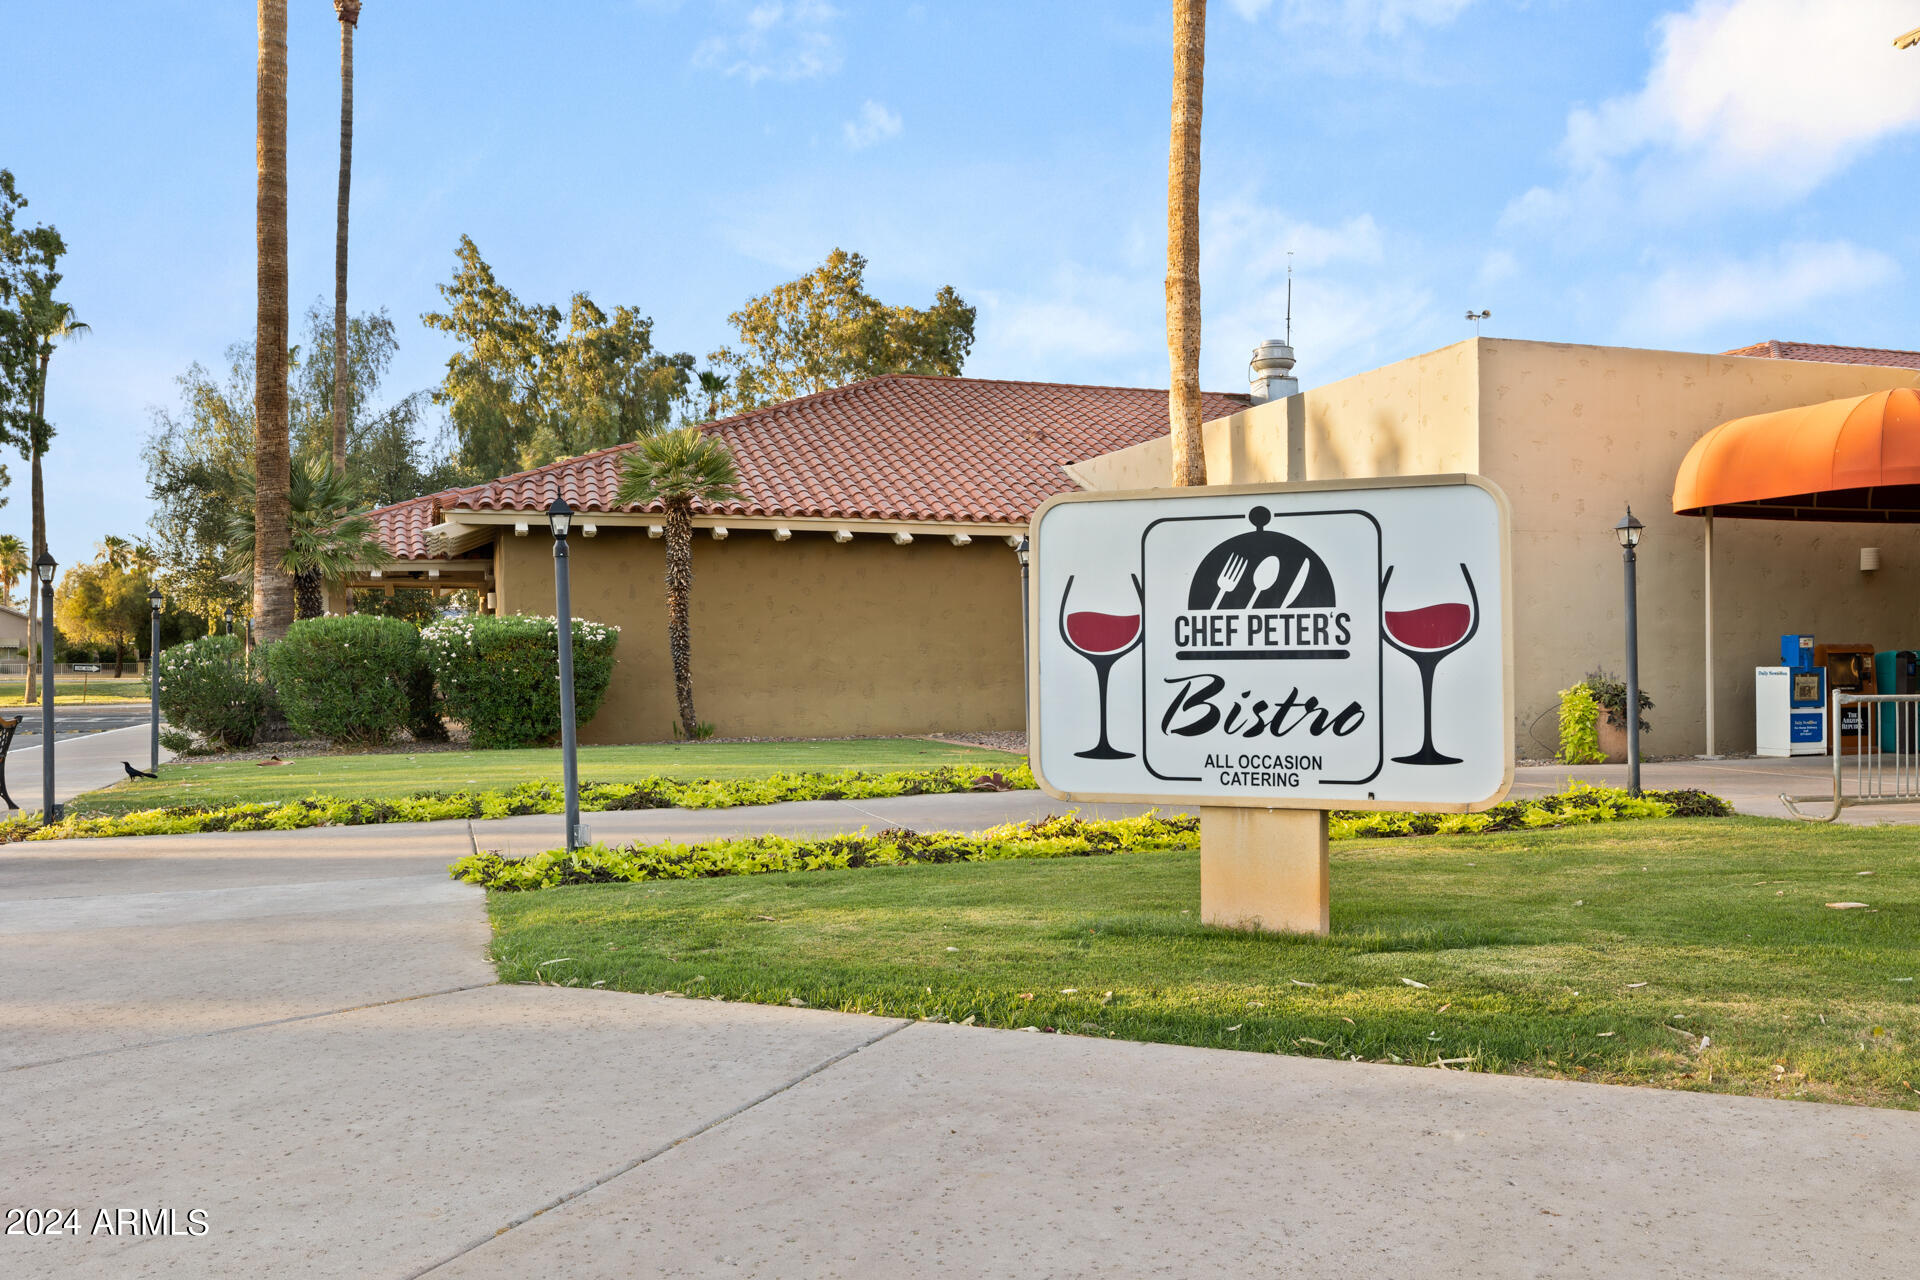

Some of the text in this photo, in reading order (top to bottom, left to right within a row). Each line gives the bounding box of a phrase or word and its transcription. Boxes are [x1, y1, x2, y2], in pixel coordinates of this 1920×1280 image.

[1174, 612, 1351, 647] CHEF PETER'S
[1161, 674, 1365, 738] Bistro
[1204, 754, 1323, 771] ALL OCCASION
[1220, 771, 1300, 787] CATERING
